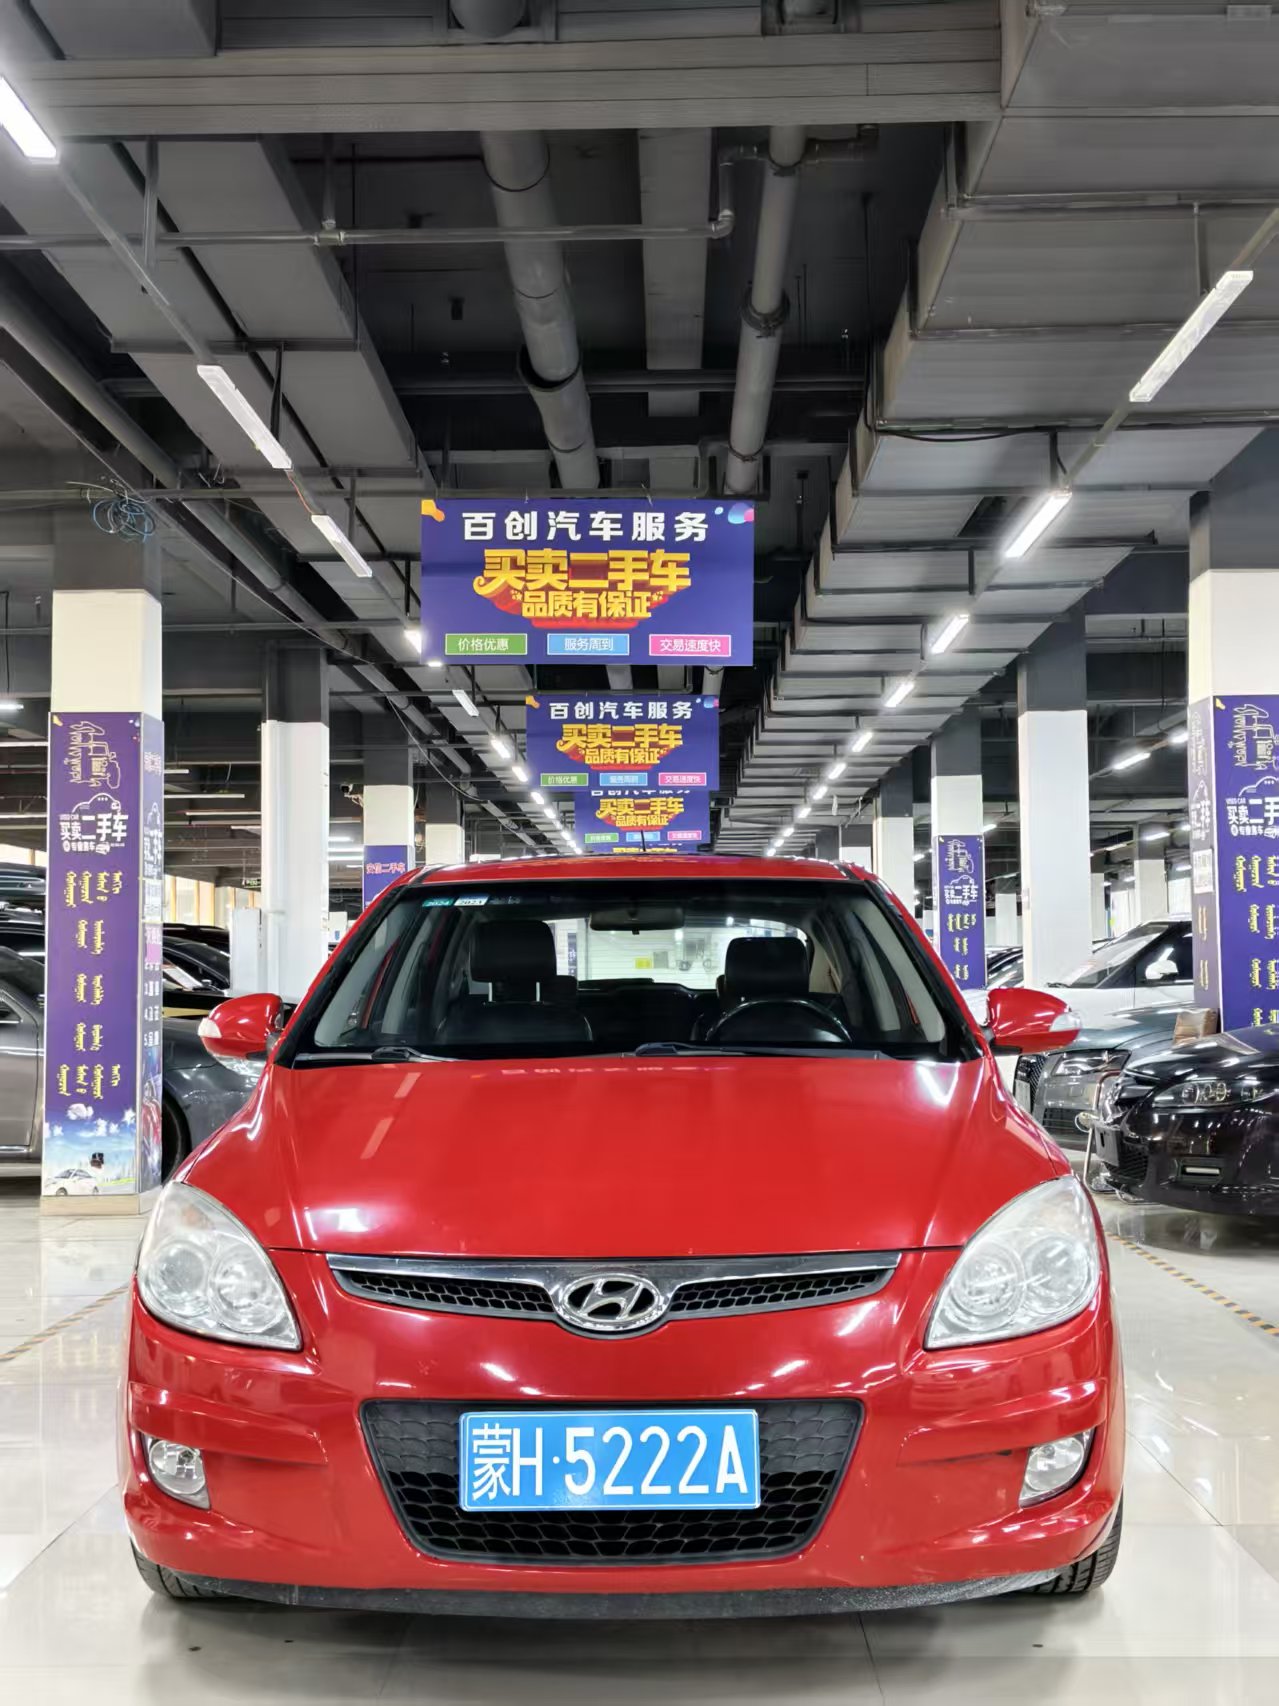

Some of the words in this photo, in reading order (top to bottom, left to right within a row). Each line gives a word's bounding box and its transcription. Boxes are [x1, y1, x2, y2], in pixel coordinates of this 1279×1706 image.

[462, 511, 709, 542] 百创汽车服务
[475, 548, 692, 593] 买卖二手车
[521, 591, 652, 618] 品质有保证
[458, 637, 510, 652] 价格优惠
[564, 637, 615, 652] 服务周到
[659, 638, 722, 653] 交易速度快
[549, 701, 693, 720] 百创汽车服务
[557, 723, 684, 749] 买卖二手车
[584, 748, 661, 765] 品质有保证
[597, 797, 685, 817] 买卖二手车
[471, 1422, 749, 1501] 蒙H·5222A
